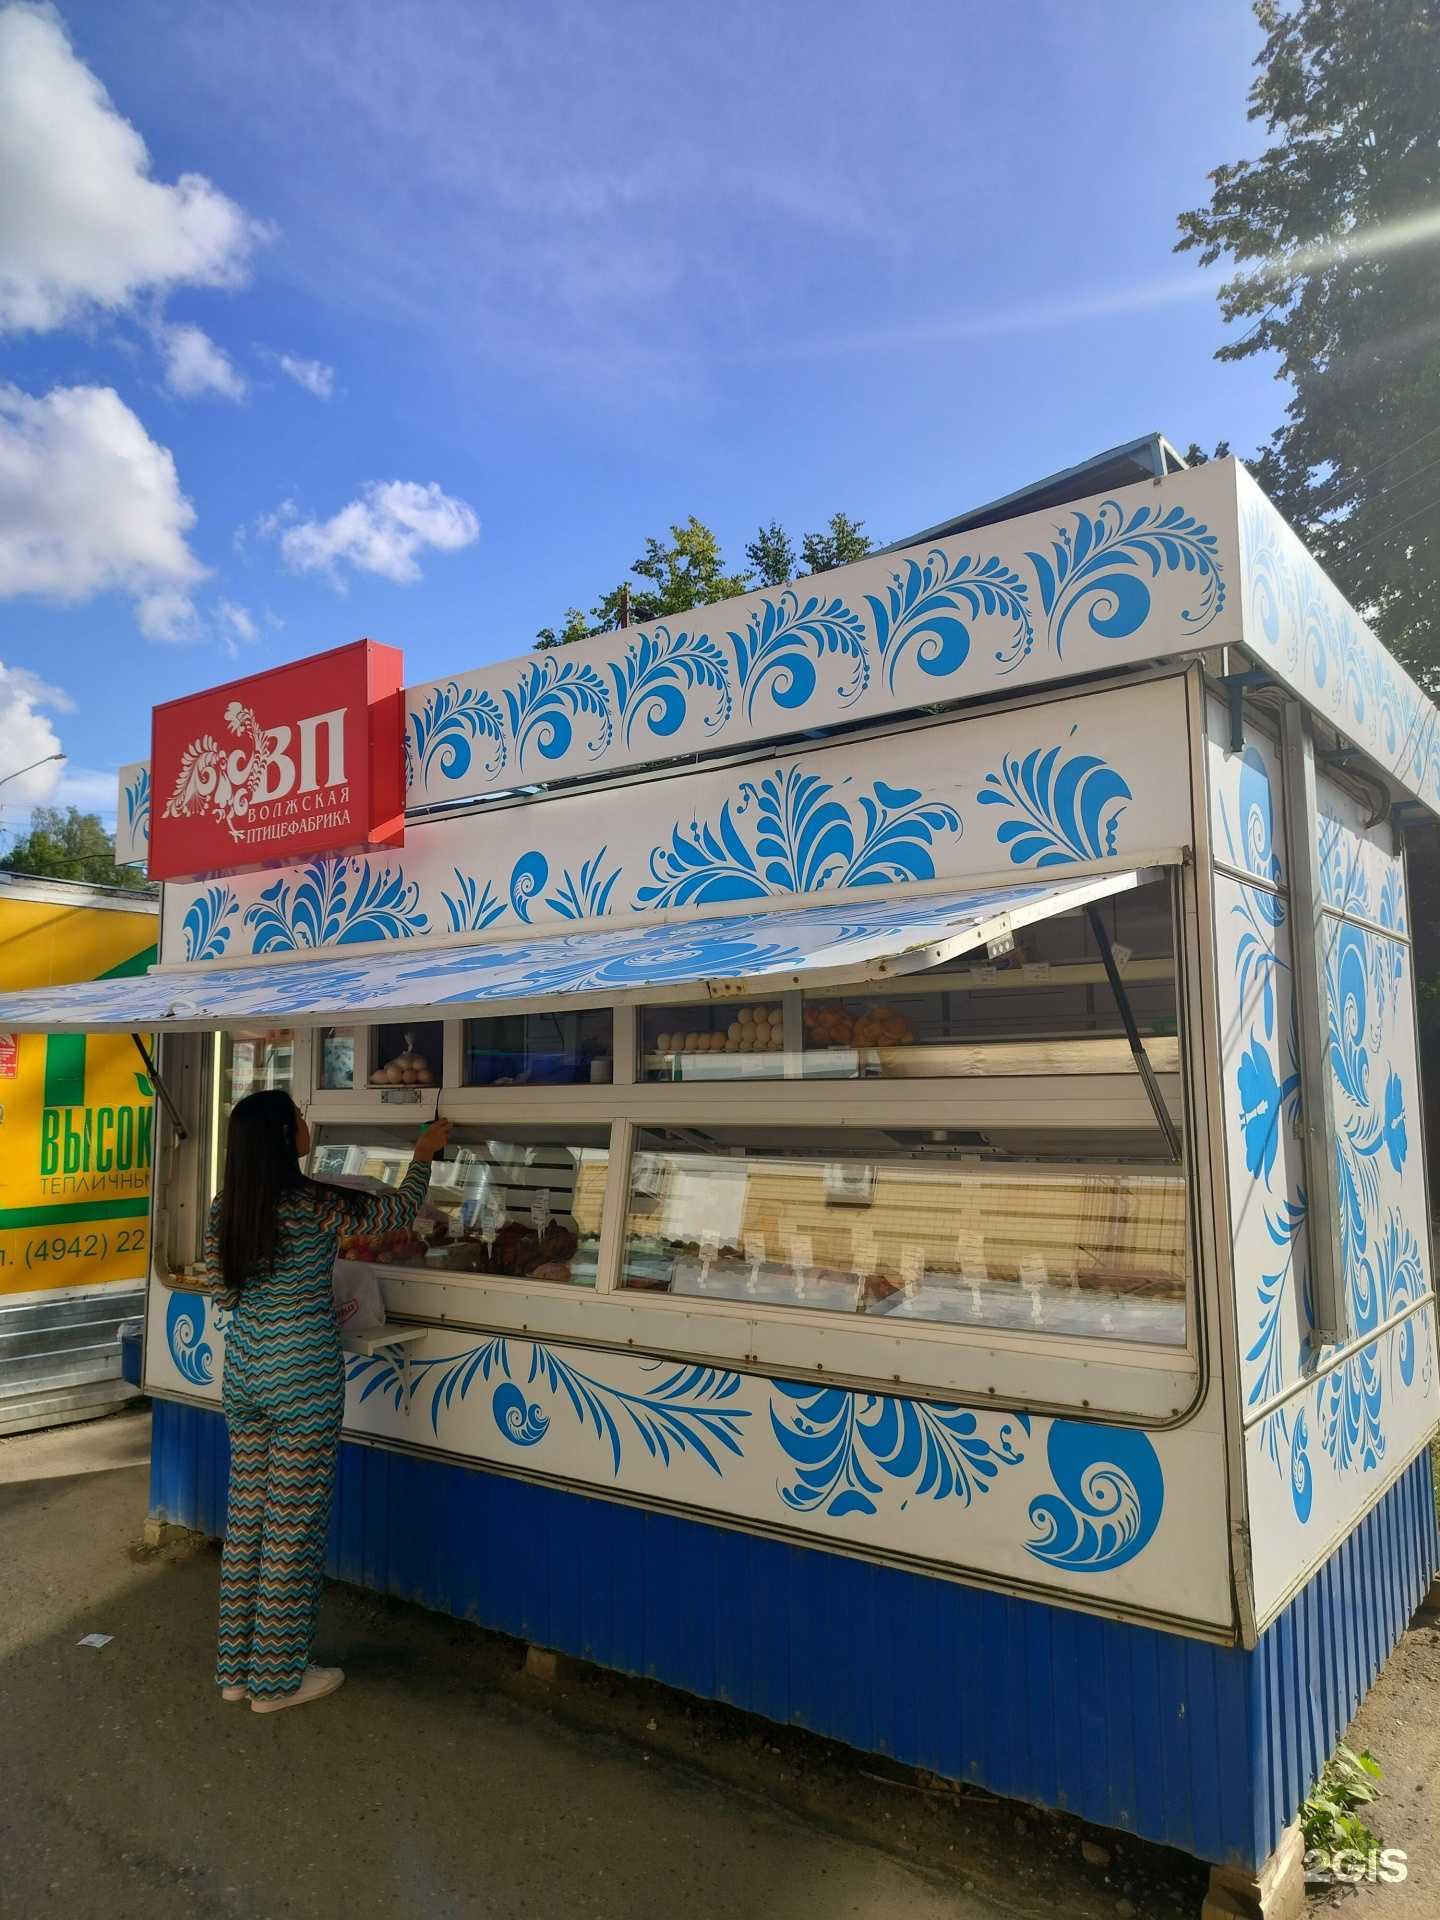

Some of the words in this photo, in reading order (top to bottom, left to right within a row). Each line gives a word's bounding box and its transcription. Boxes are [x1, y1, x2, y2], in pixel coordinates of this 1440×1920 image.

[249, 707, 349, 805] ВП
[248, 787, 350, 823] ВОЛЖСКАЯ
[247, 809, 351, 844] ПТИЦЕФАБРИКА
[25, 1232, 108, 1269] (4942)
[116, 1229, 145, 1253] 22
